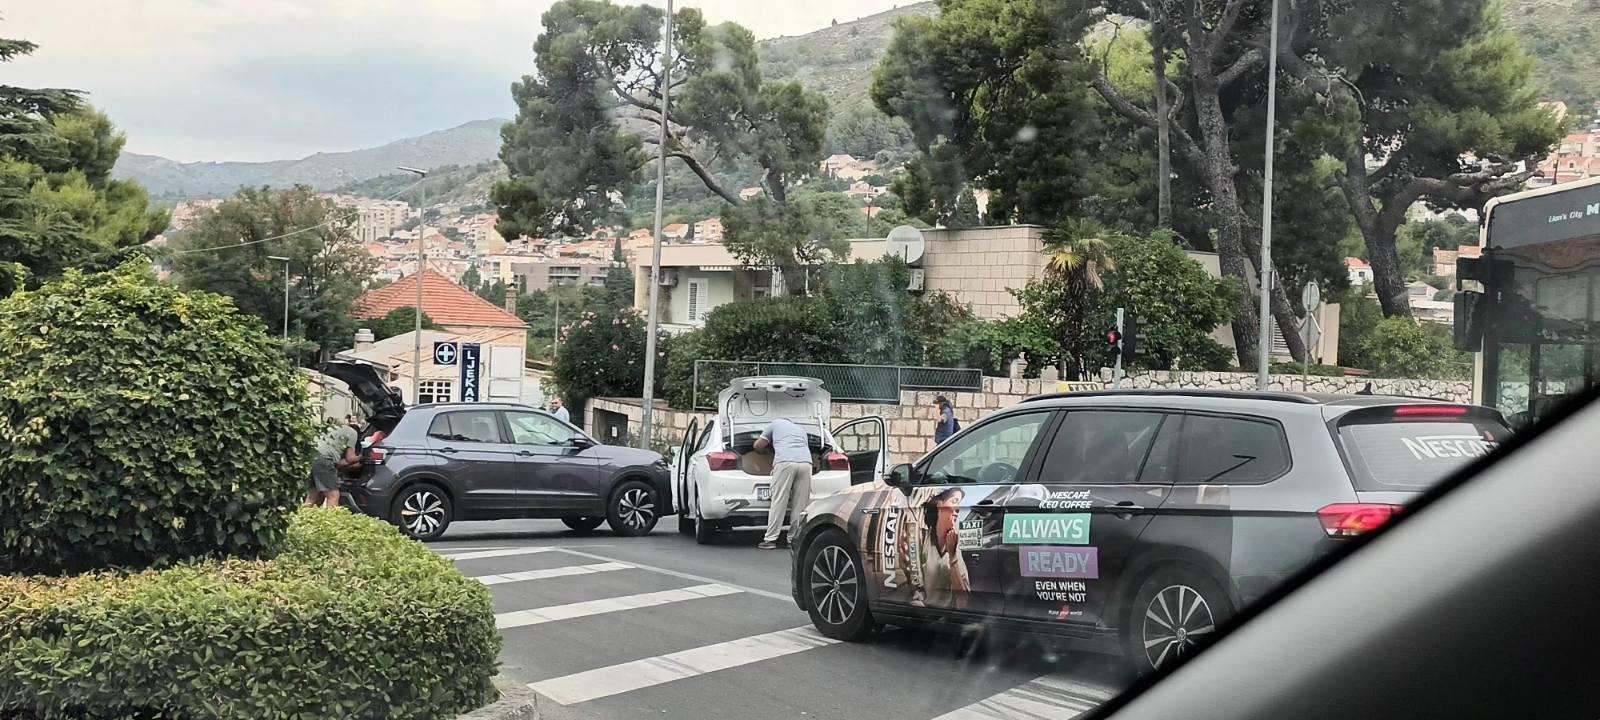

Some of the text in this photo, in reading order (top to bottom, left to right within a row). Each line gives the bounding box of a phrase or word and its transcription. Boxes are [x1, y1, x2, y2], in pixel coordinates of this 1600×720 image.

[1569, 210, 1583, 219] City
[1059, 500, 1093, 509] COFFEE
[961, 521, 981, 529] TAXI
[1009, 519, 1083, 538] ALWAYS
[1027, 551, 1090, 573] READY
[1035, 580, 1086, 592] EVEN WHEN
[1037, 591, 1087, 602] YOU'RE NOT
